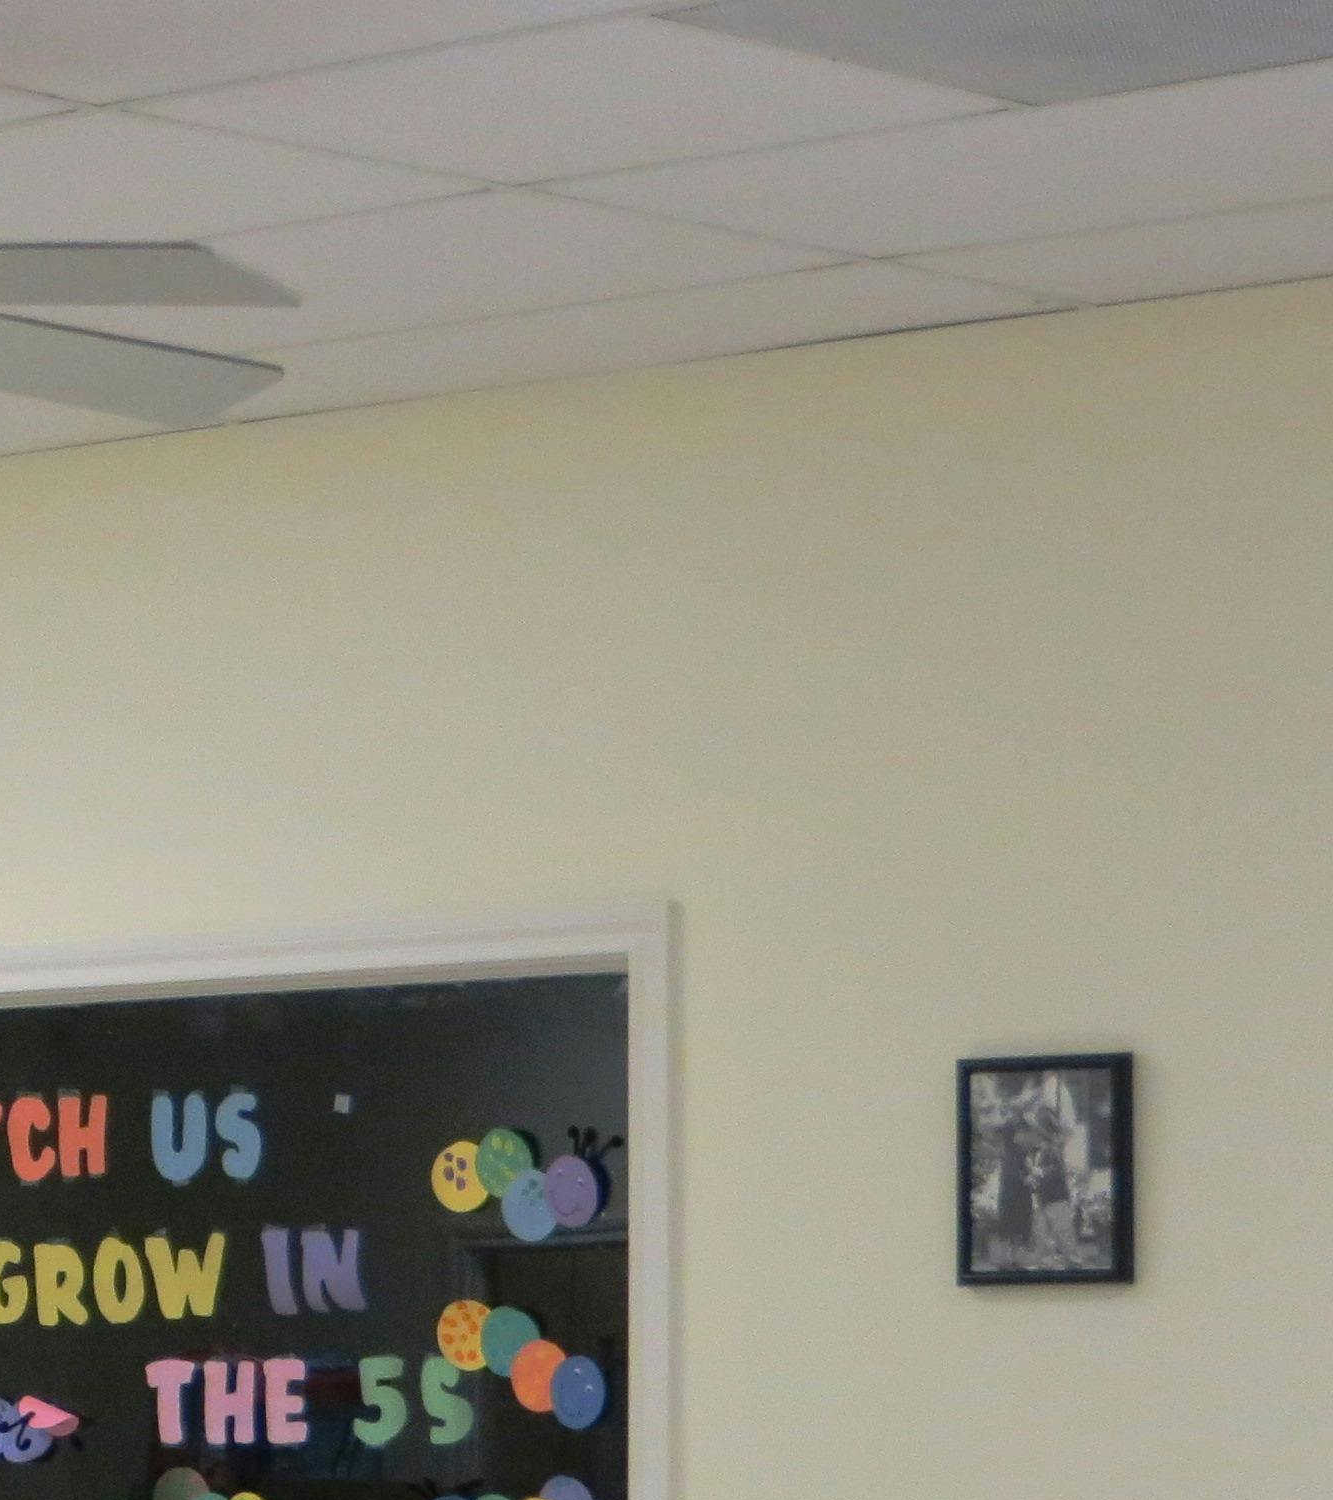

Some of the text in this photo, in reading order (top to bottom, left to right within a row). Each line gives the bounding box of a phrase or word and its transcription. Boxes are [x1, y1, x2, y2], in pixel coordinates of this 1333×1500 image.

[150, 1091, 265, 1186] US
[260, 1226, 369, 1317] IN
[145, 1354, 476, 1448] THE 5S
